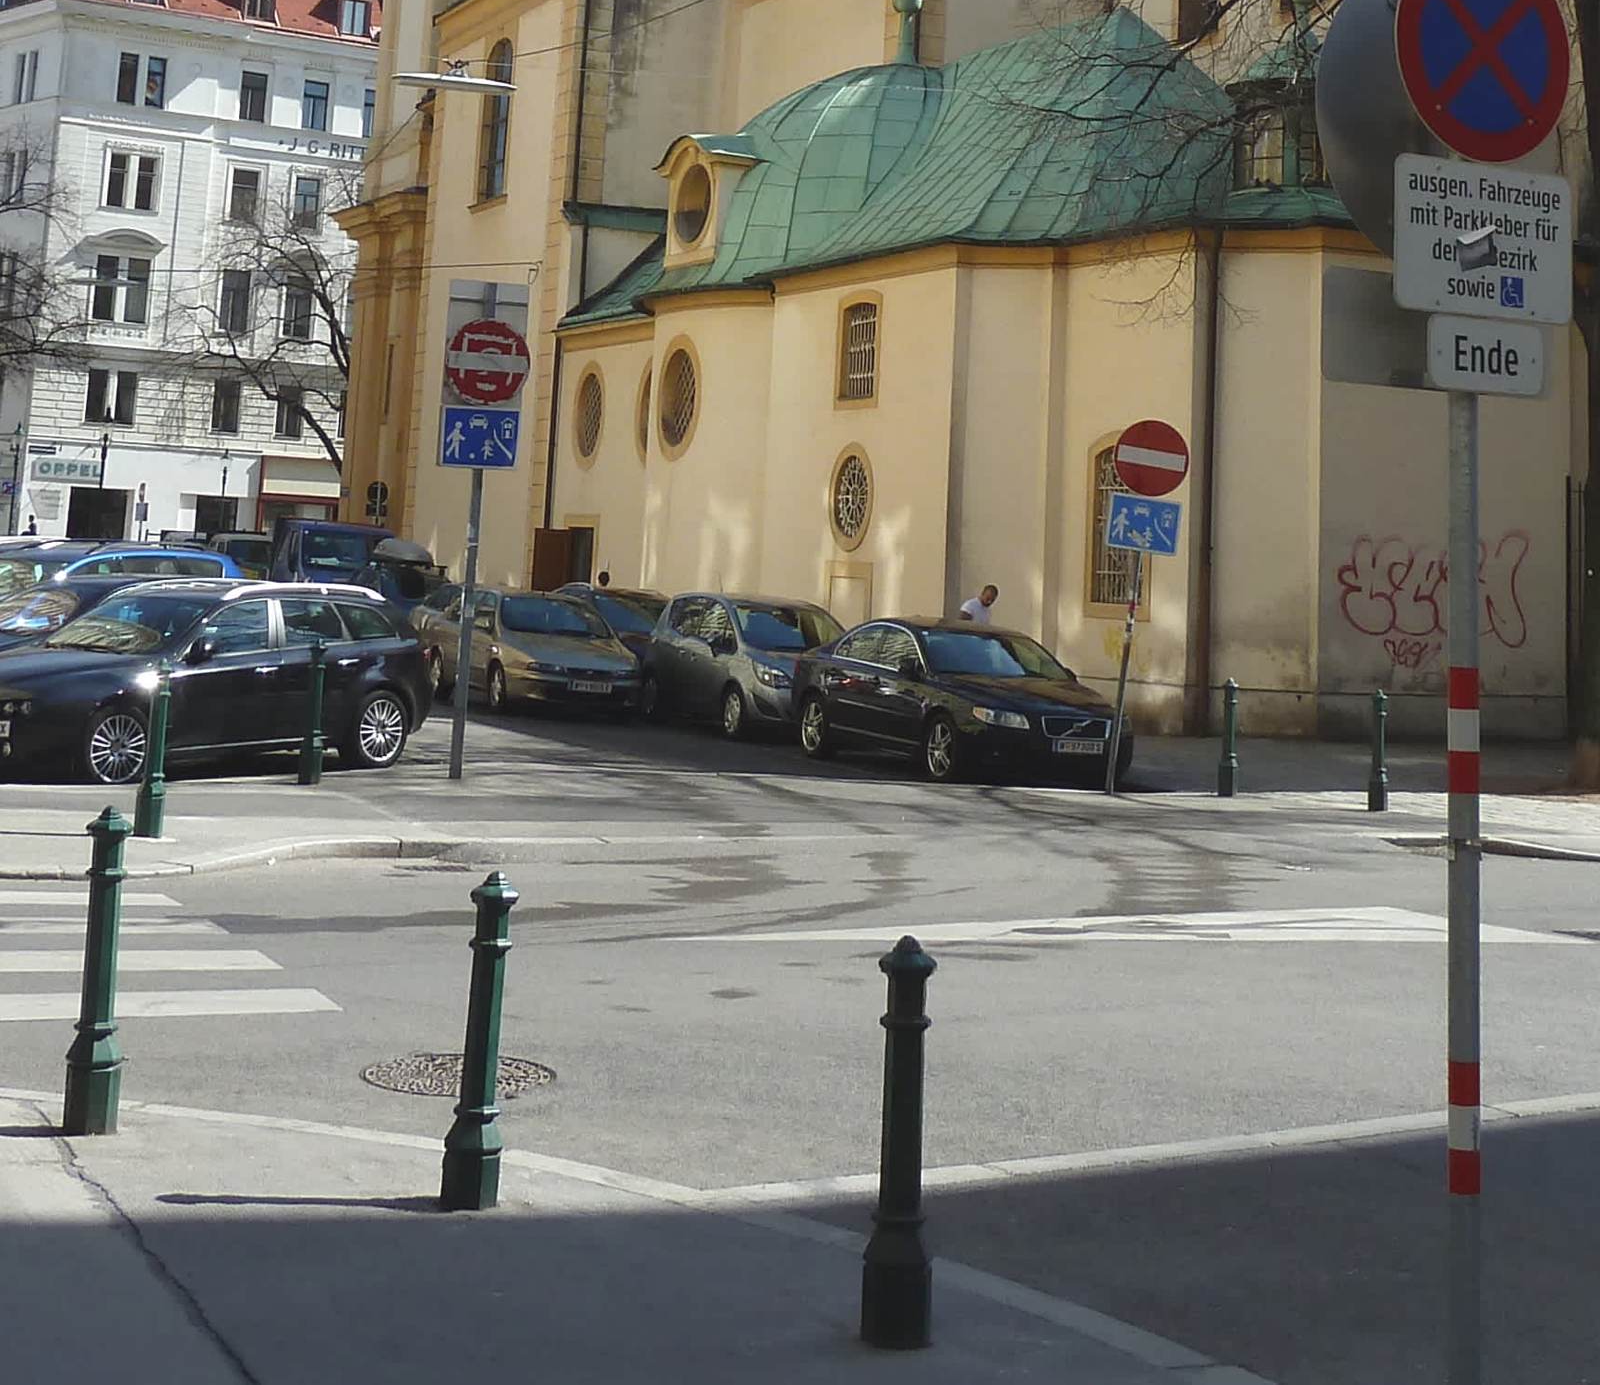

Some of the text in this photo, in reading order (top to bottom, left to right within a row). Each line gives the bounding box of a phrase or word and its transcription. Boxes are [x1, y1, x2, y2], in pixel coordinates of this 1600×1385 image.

[1408, 172, 1561, 214] ausgen. Fahrzeuge
[1410, 201, 1559, 242] mit Parkkleber für
[1497, 247, 1538, 272] ezirk
[1447, 275, 1496, 300] sowie
[1454, 334, 1519, 376] Ende
[39, 461, 101, 478] OPPEL
